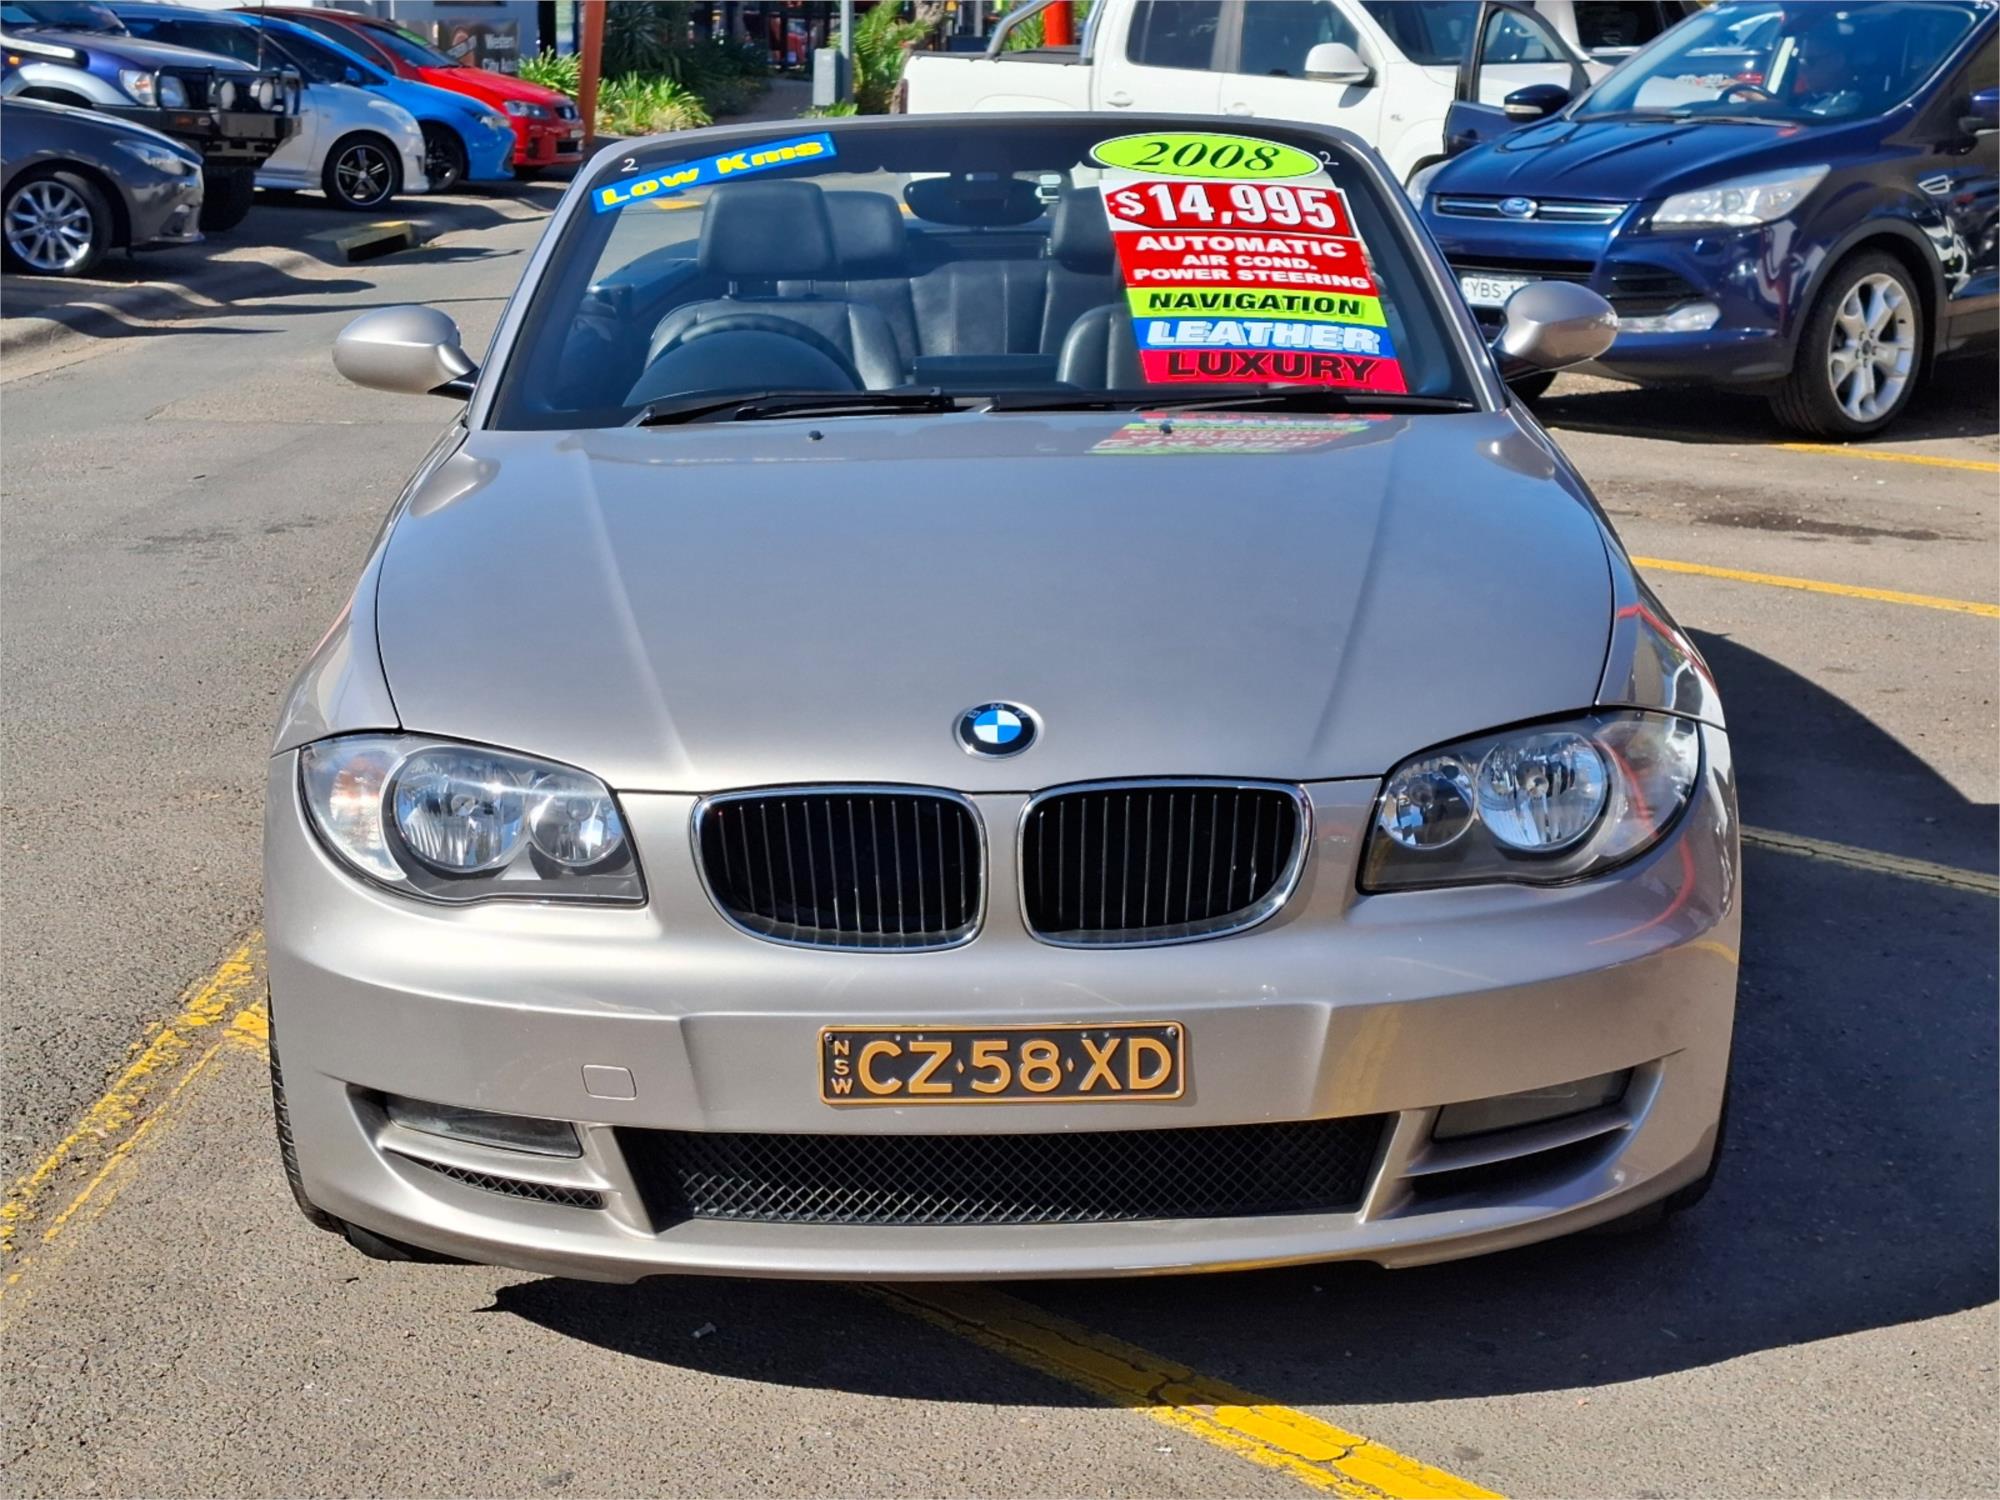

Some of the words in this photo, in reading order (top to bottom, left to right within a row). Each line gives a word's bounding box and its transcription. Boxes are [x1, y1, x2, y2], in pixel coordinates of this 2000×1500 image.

[620, 158, 638, 172] 2
[716, 142, 824, 174] Kms
[1132, 141, 1281, 170] 2008
[1319, 151, 1339, 166] 2
[1114, 184, 1336, 229] $14,995
[1136, 236, 1347, 258] AUTOMATIC
[1182, 254, 1229, 267] AIR
[1235, 256, 1317, 270] COND.
[1133, 268, 1231, 281] POWER
[1239, 269, 1371, 290] STEERING
[1148, 292, 1361, 316] NAVIGATION
[1147, 320, 1381, 354] LEATHER
[1167, 351, 1382, 382] LUXURY
[832, 1039, 854, 1096] NSW
